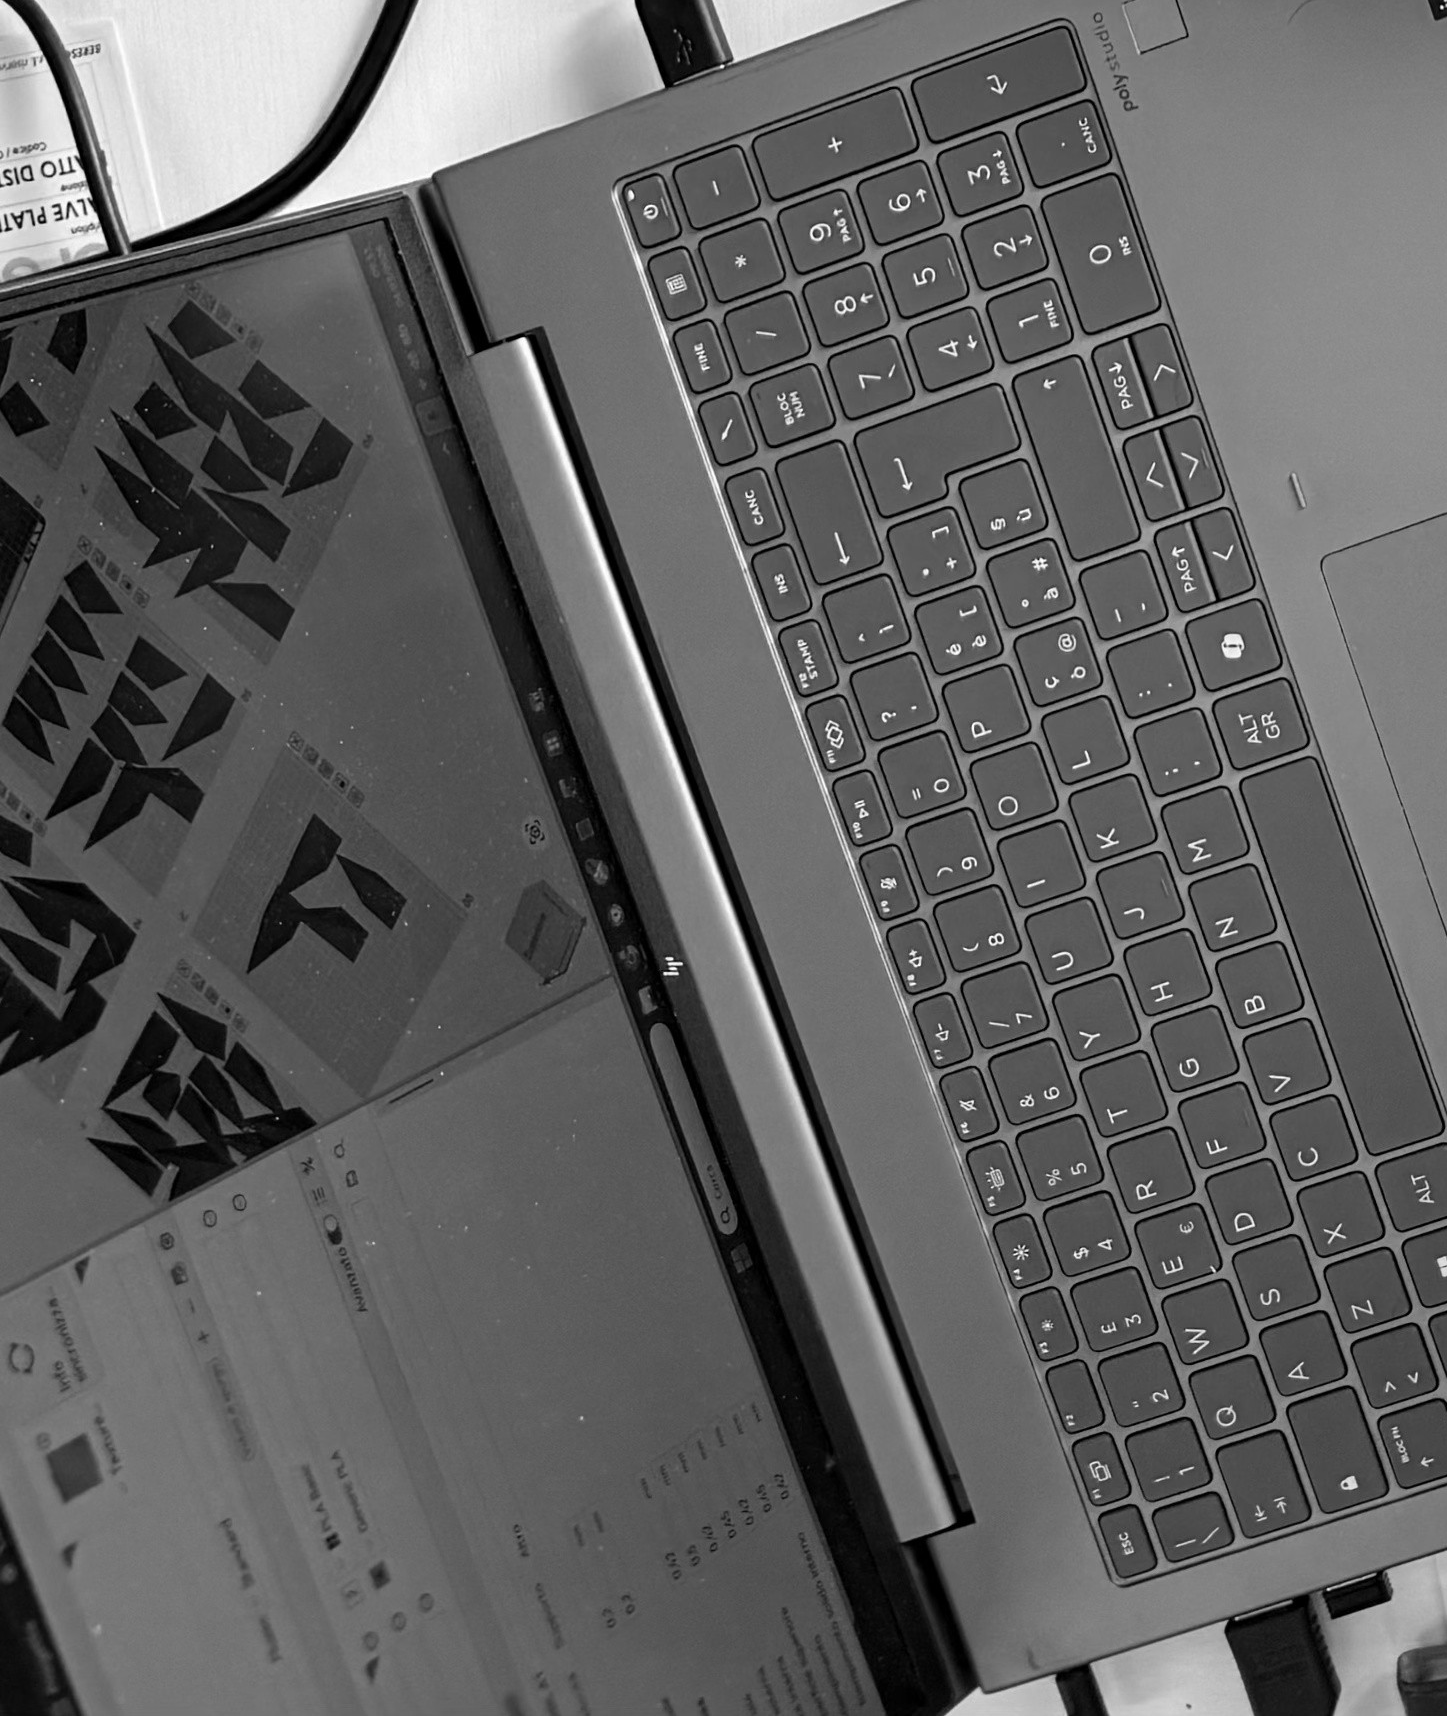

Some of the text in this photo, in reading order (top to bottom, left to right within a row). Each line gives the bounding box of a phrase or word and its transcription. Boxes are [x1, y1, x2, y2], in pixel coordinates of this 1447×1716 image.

[1092, 11, 1139, 112] poly studio
[1078, 117, 1097, 154] CANC
[996, 159, 1011, 185] PAG
[836, 217, 852, 243] PAG
[1043, 299, 1060, 328] FINE
[694, 342, 711, 372] FINE
[789, 391, 806, 419] NUM
[1113, 375, 1134, 410] PAG
[776, 392, 795, 426] BLOC
[744, 489, 764, 526] CANC
[774, 573, 789, 594] INS
[1176, 558, 1197, 593] PAG
[797, 639, 818, 680] STAMP
[1238, 713, 1263, 744] ALT
[1260, 711, 1281, 739] GR
[1410, 1174, 1435, 1204] ALT
[333, 1242, 370, 1315] Avanzato
[49, 1358, 73, 1395] Info
[1391, 1426, 1410, 1464] BLOC FN
[1118, 1532, 1135, 1556] ESC
